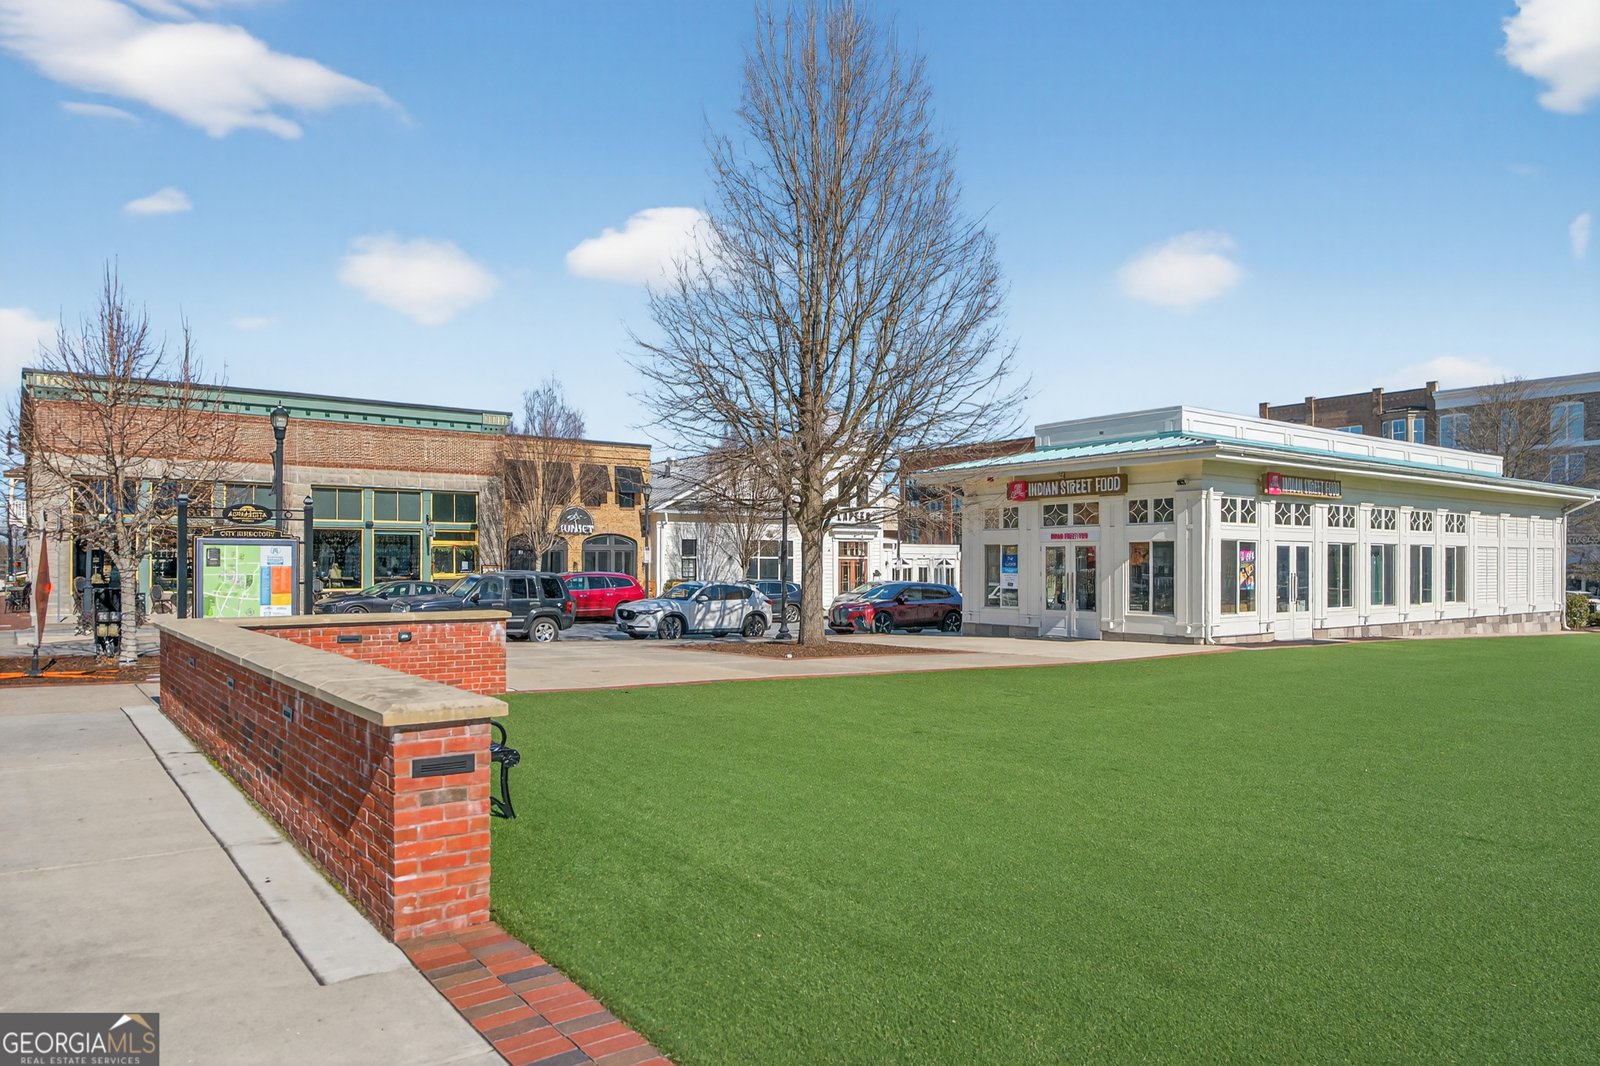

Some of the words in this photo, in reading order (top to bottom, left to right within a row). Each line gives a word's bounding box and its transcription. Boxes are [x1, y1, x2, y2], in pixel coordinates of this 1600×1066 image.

[1028, 481, 1058, 496] INDIAN
[1060, 478, 1093, 495] STREET
[1095, 476, 1121, 492] FOOD
